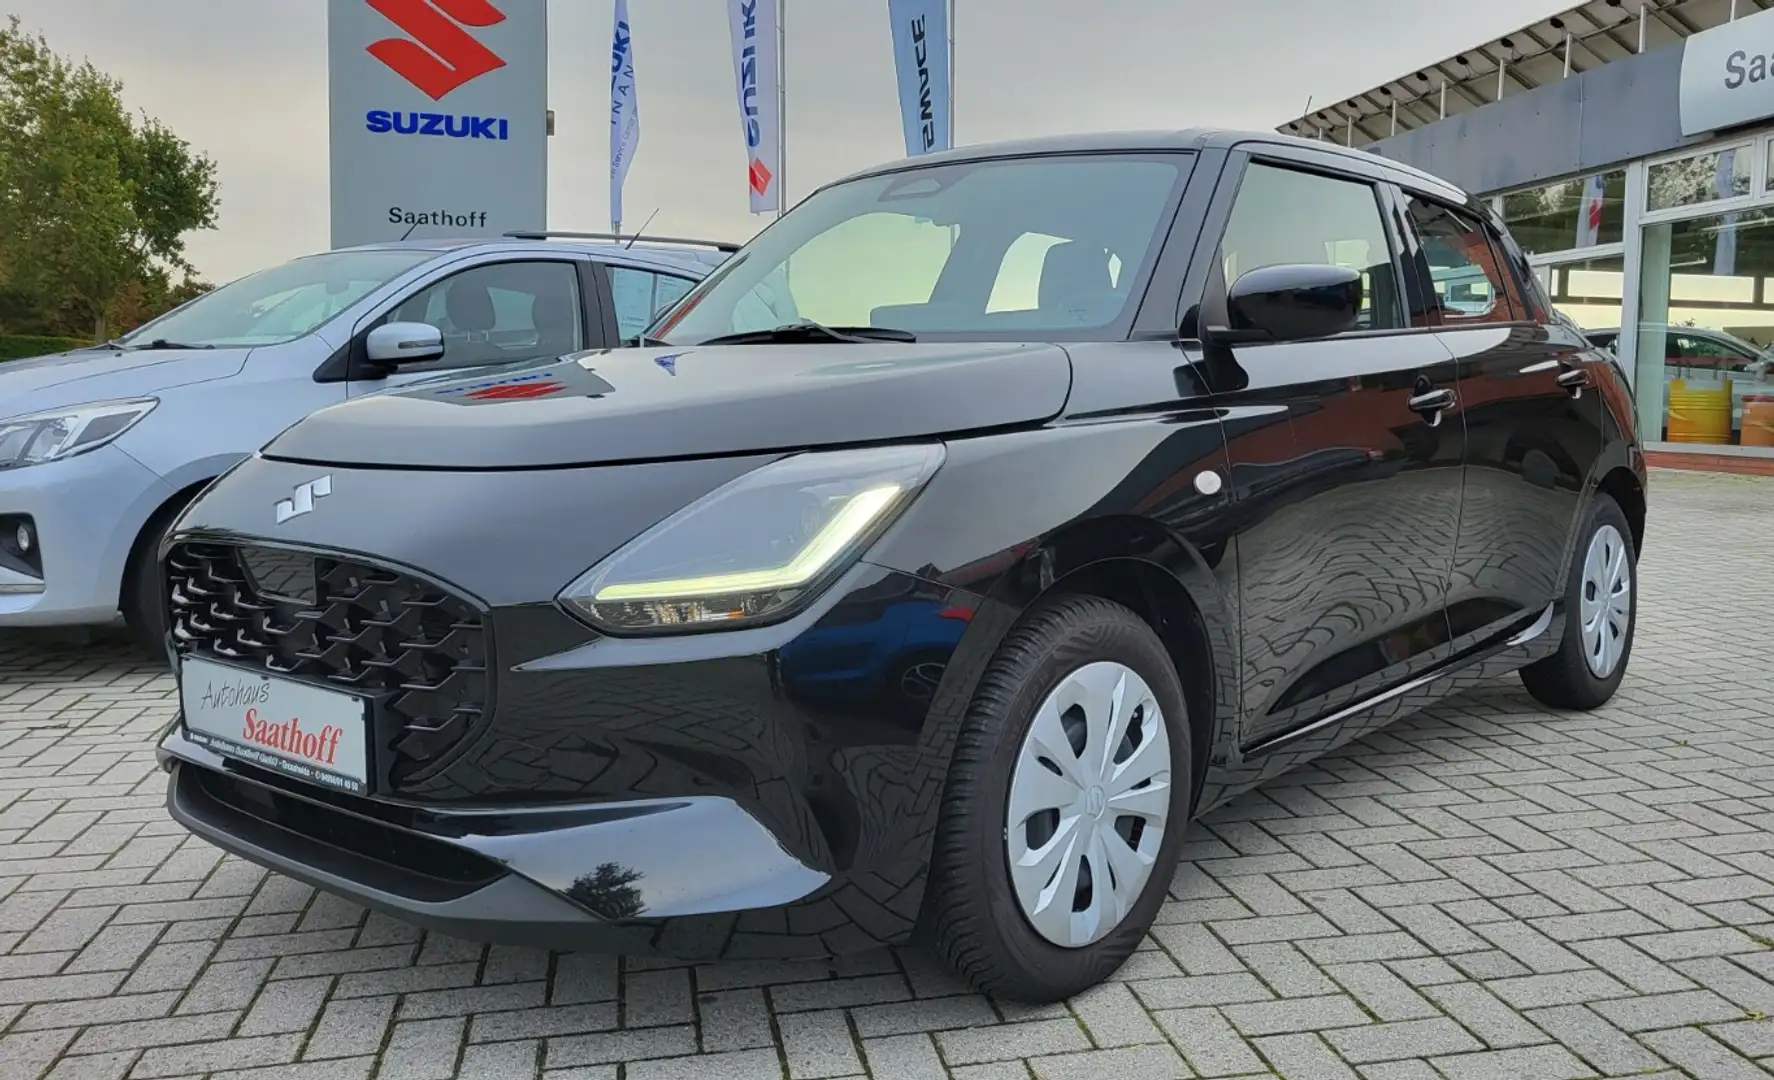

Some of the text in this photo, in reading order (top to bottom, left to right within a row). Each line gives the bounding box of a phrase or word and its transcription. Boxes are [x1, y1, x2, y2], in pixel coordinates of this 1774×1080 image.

[1724, 50, 1774, 89] Sa
[366, 110, 508, 140] SUZUKI
[388, 206, 487, 227] Saathoff
[200, 678, 270, 710] Autohaus
[242, 708, 343, 764] Saathoff
